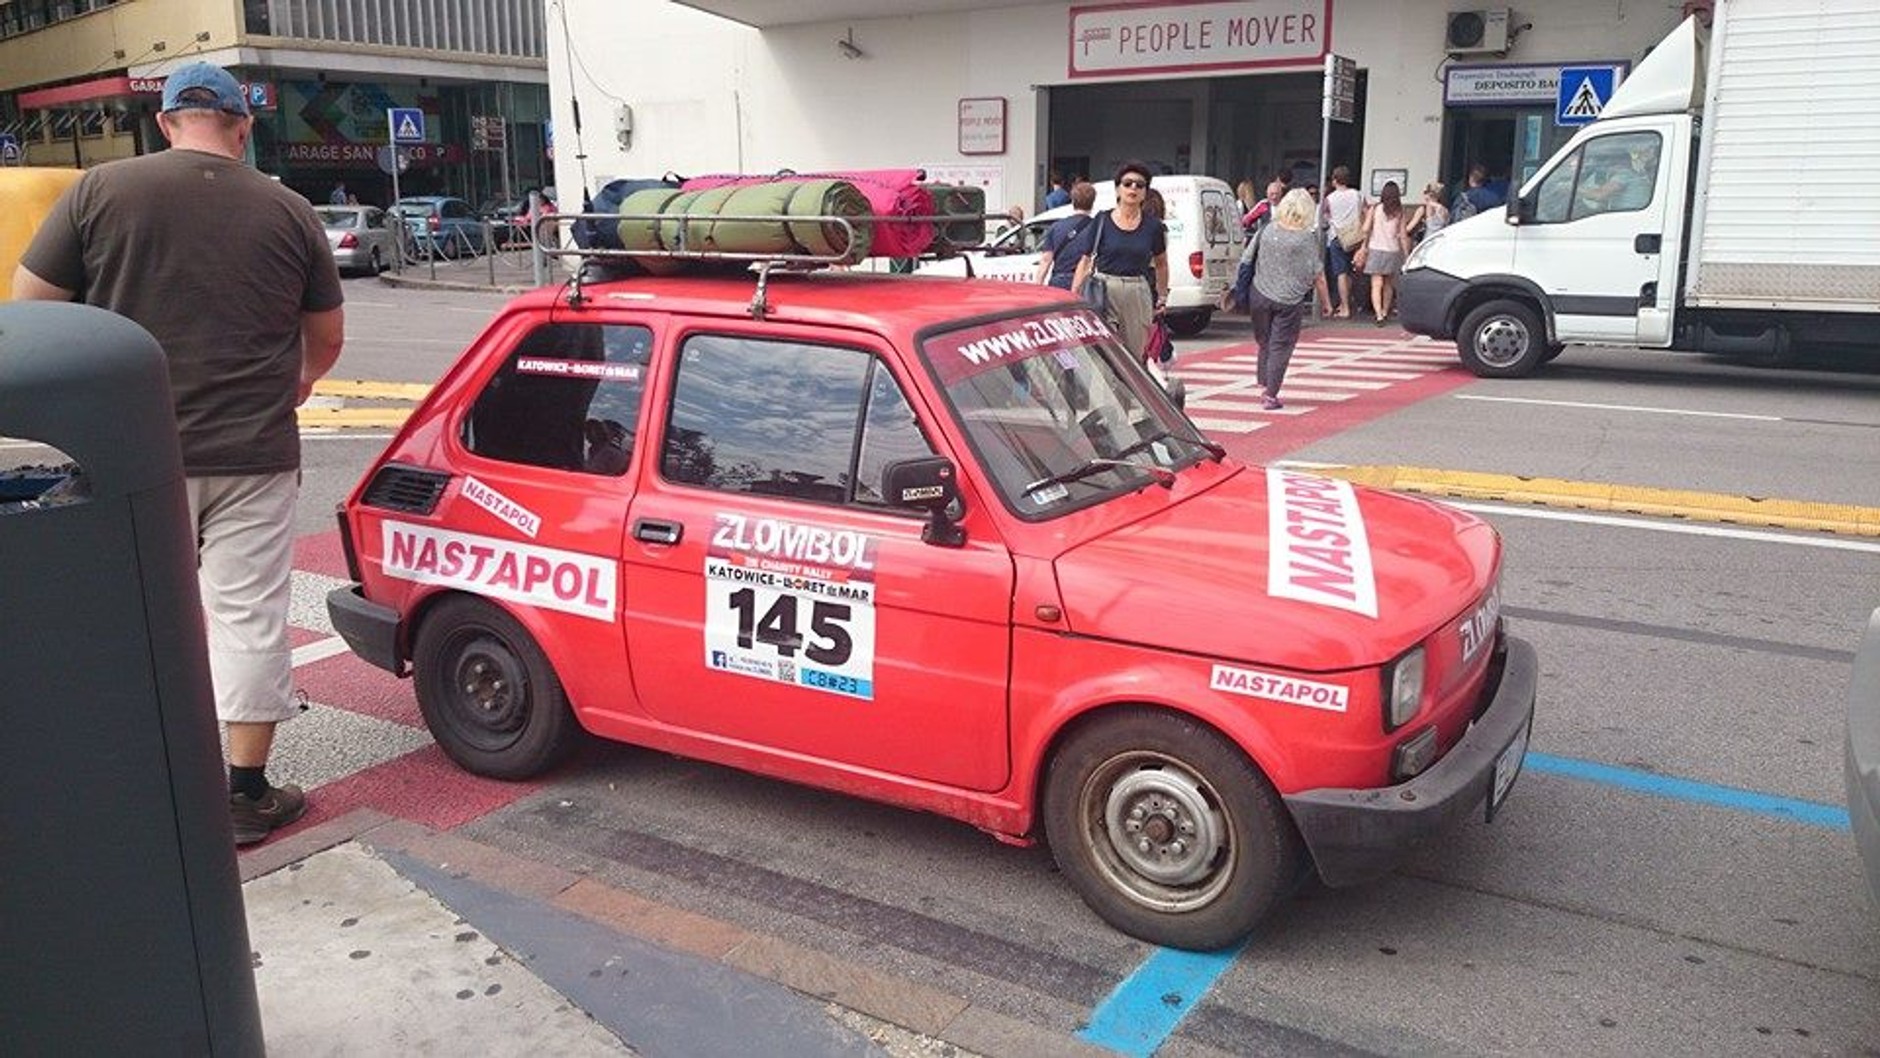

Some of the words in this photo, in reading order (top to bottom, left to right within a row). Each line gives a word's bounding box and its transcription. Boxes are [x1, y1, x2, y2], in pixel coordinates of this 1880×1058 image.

[1119, 20, 1213, 54] PEOPLE
[1227, 13, 1316, 47] MOVER
[1474, 80, 1536, 91] DEPOSITO
[288, 145, 339, 160] ARAGE
[342, 145, 374, 160] SAN
[465, 480, 538, 534] NASTAPOL
[390, 530, 609, 609] NASTAPOL
[838, 587, 869, 601] MAR
[729, 587, 853, 667] 145
[1215, 669, 1345, 708] NASTAPOL
